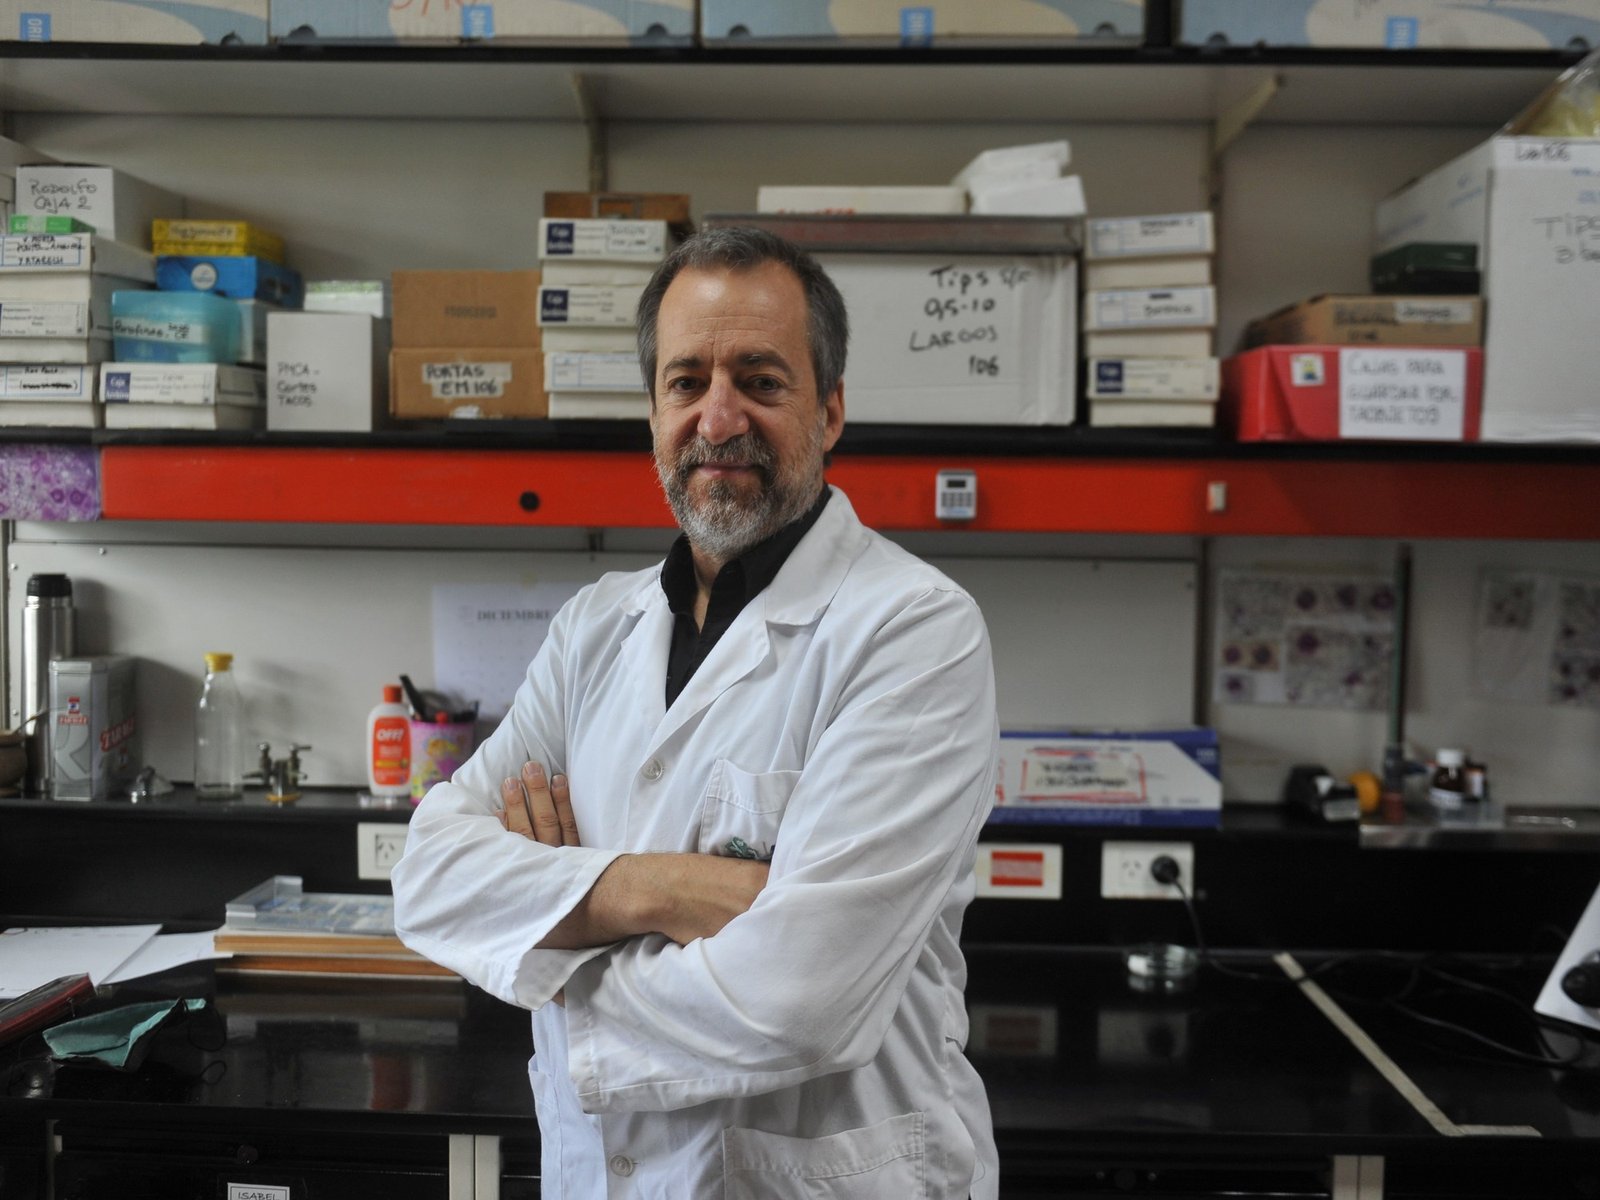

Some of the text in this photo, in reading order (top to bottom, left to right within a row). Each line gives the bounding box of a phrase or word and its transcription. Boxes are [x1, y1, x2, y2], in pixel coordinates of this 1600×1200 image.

[28, 178, 98, 196] RODOLFO
[77, 195, 92, 210] 2
[930, 264, 989, 294] Tips
[426, 363, 485, 379] PORTAS
[968, 354, 1000, 377] 106
[441, 377, 498, 395] EM 106
[377, 728, 404, 741] OFF!
